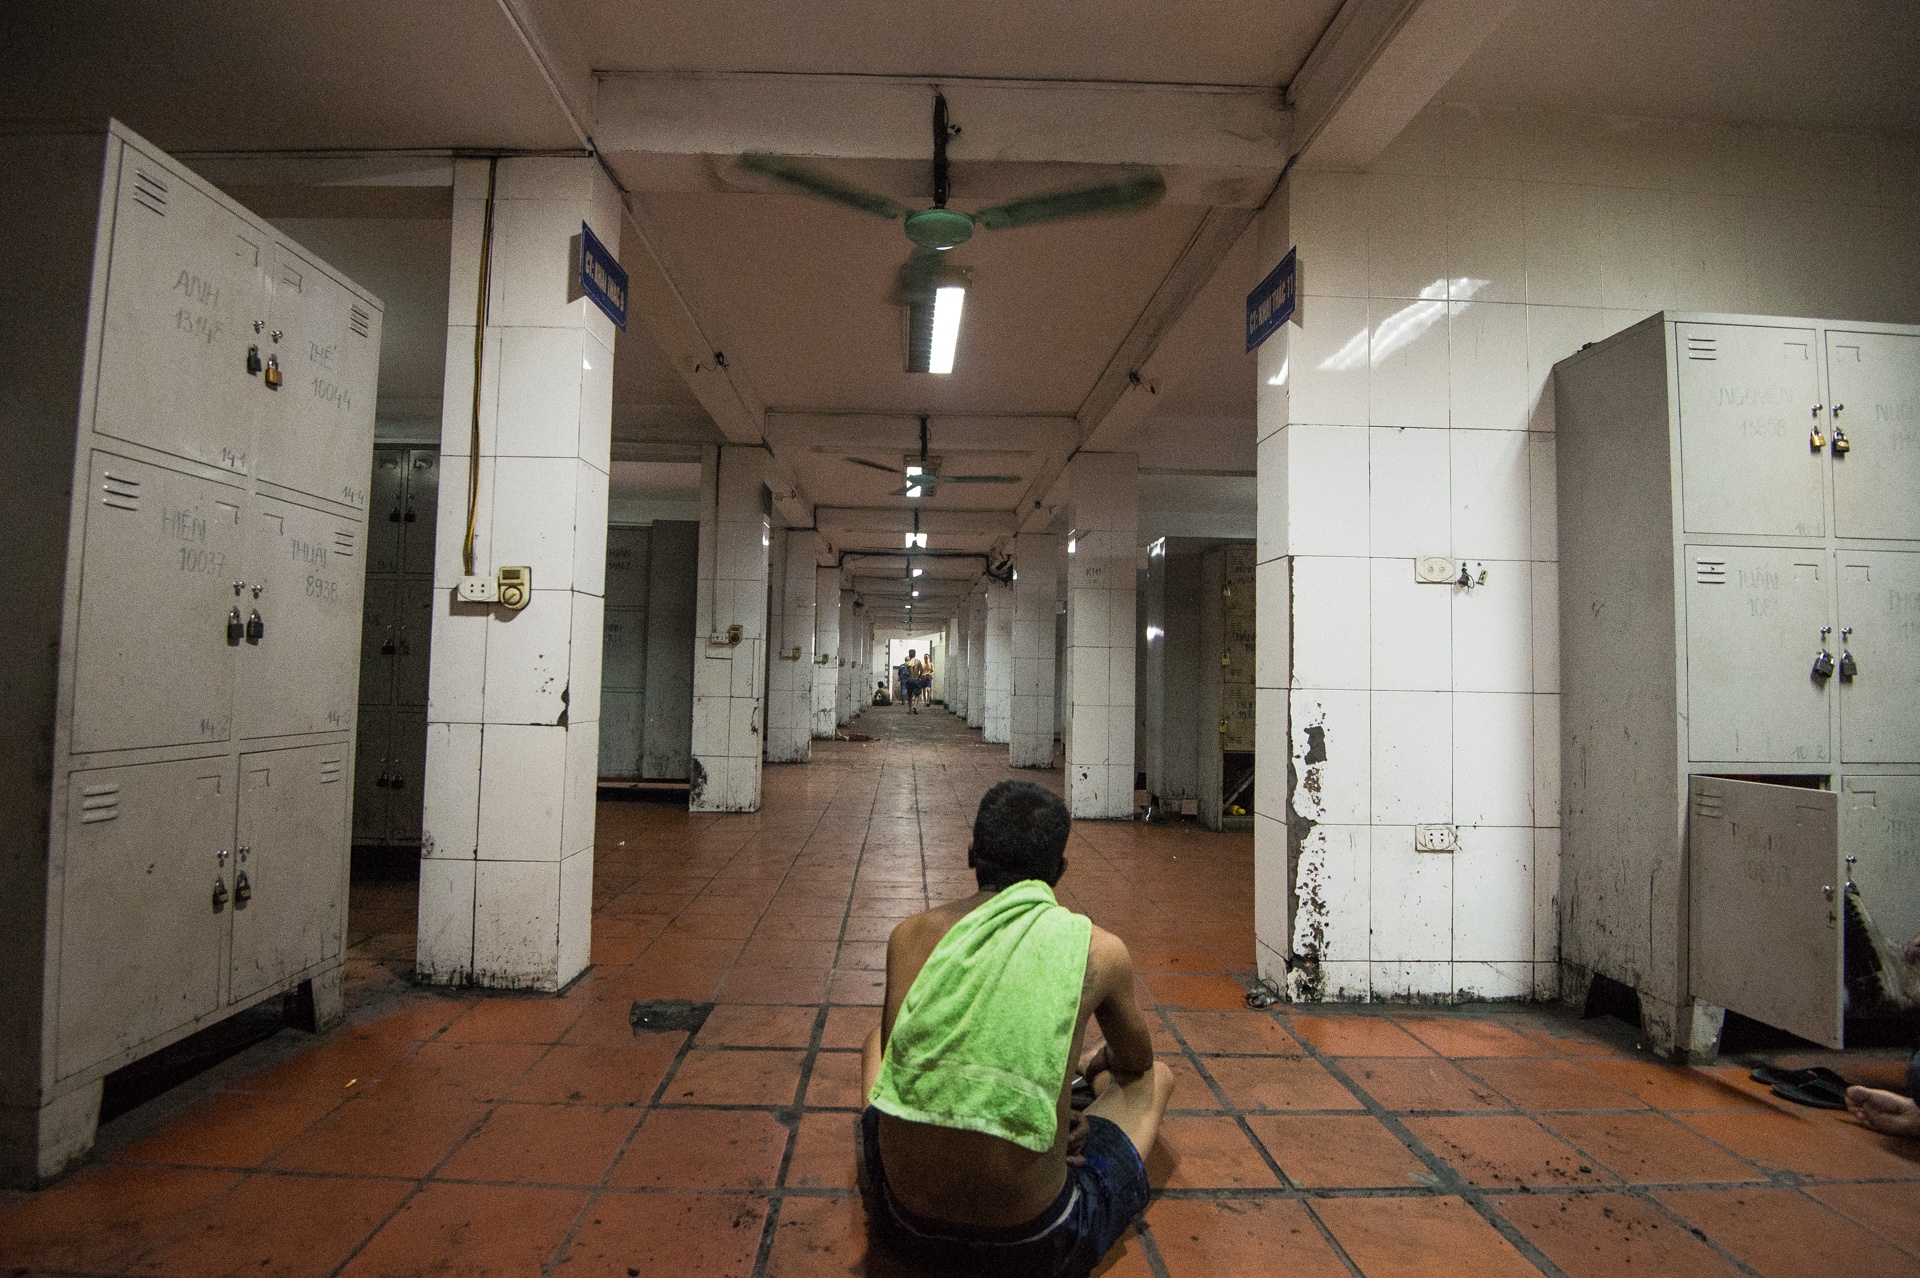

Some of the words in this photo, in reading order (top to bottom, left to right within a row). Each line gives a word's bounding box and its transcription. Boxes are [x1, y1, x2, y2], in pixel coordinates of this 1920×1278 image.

[172, 269, 220, 309] ANH
[311, 376, 352, 412] 10044
[179, 547, 227, 578] 10037
